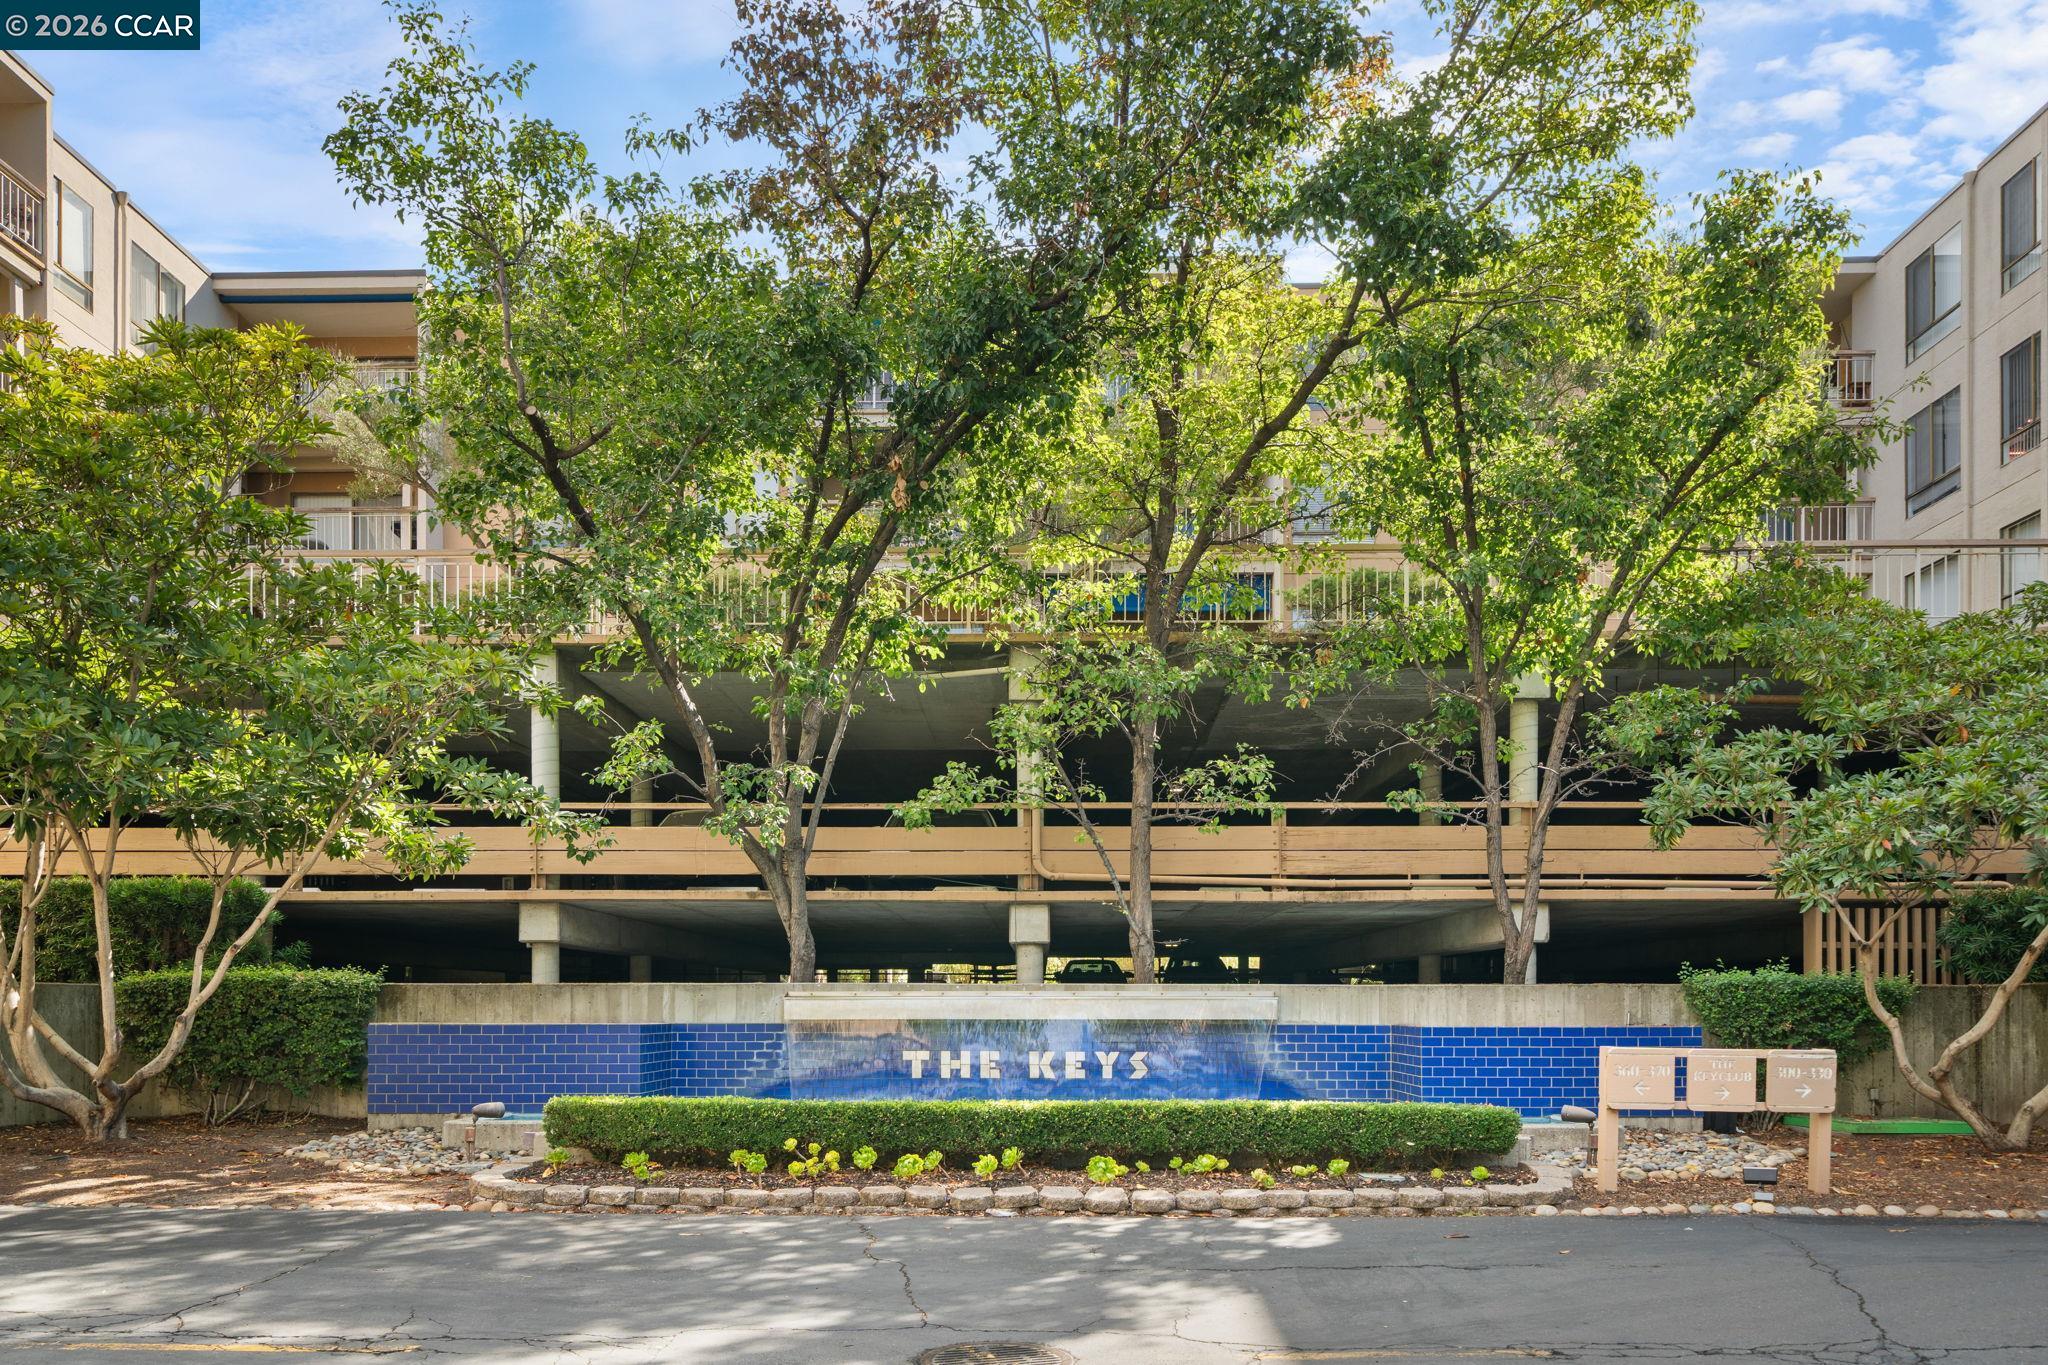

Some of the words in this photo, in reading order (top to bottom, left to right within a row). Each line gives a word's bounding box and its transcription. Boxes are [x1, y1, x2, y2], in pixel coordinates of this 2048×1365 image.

[902, 1050, 1000, 1079] THE
[1029, 1051, 1149, 1079] KEYS
[1710, 1058, 1736, 1069] THE
